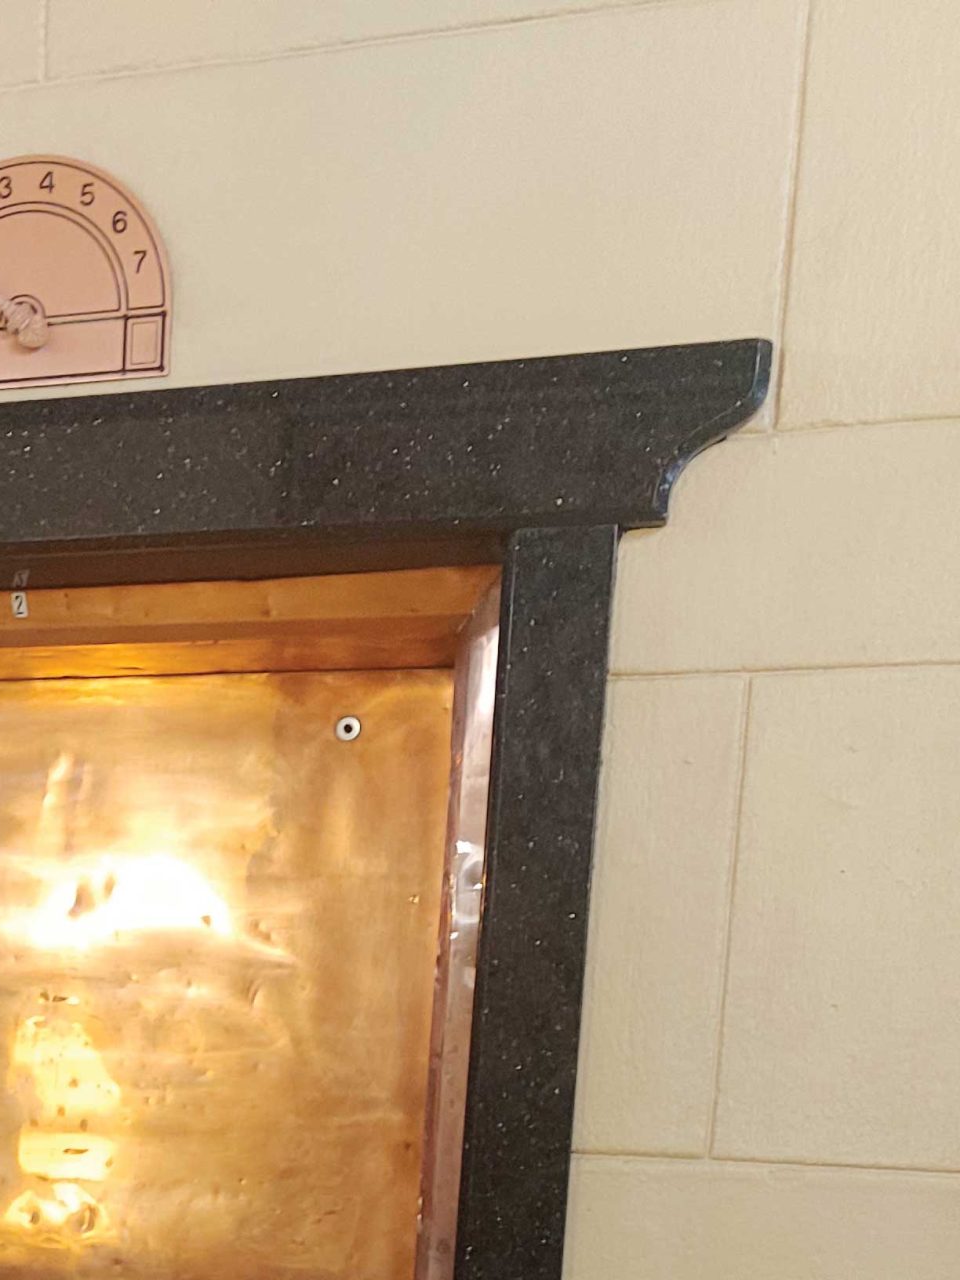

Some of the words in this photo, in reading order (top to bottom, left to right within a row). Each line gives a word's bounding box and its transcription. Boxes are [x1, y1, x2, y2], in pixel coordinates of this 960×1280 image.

[39, 171, 55, 193] 4
[80, 183, 96, 206] 5
[112, 211, 127, 233] 6
[133, 251, 147, 274] 7
[15, 595, 24, 615] 2
